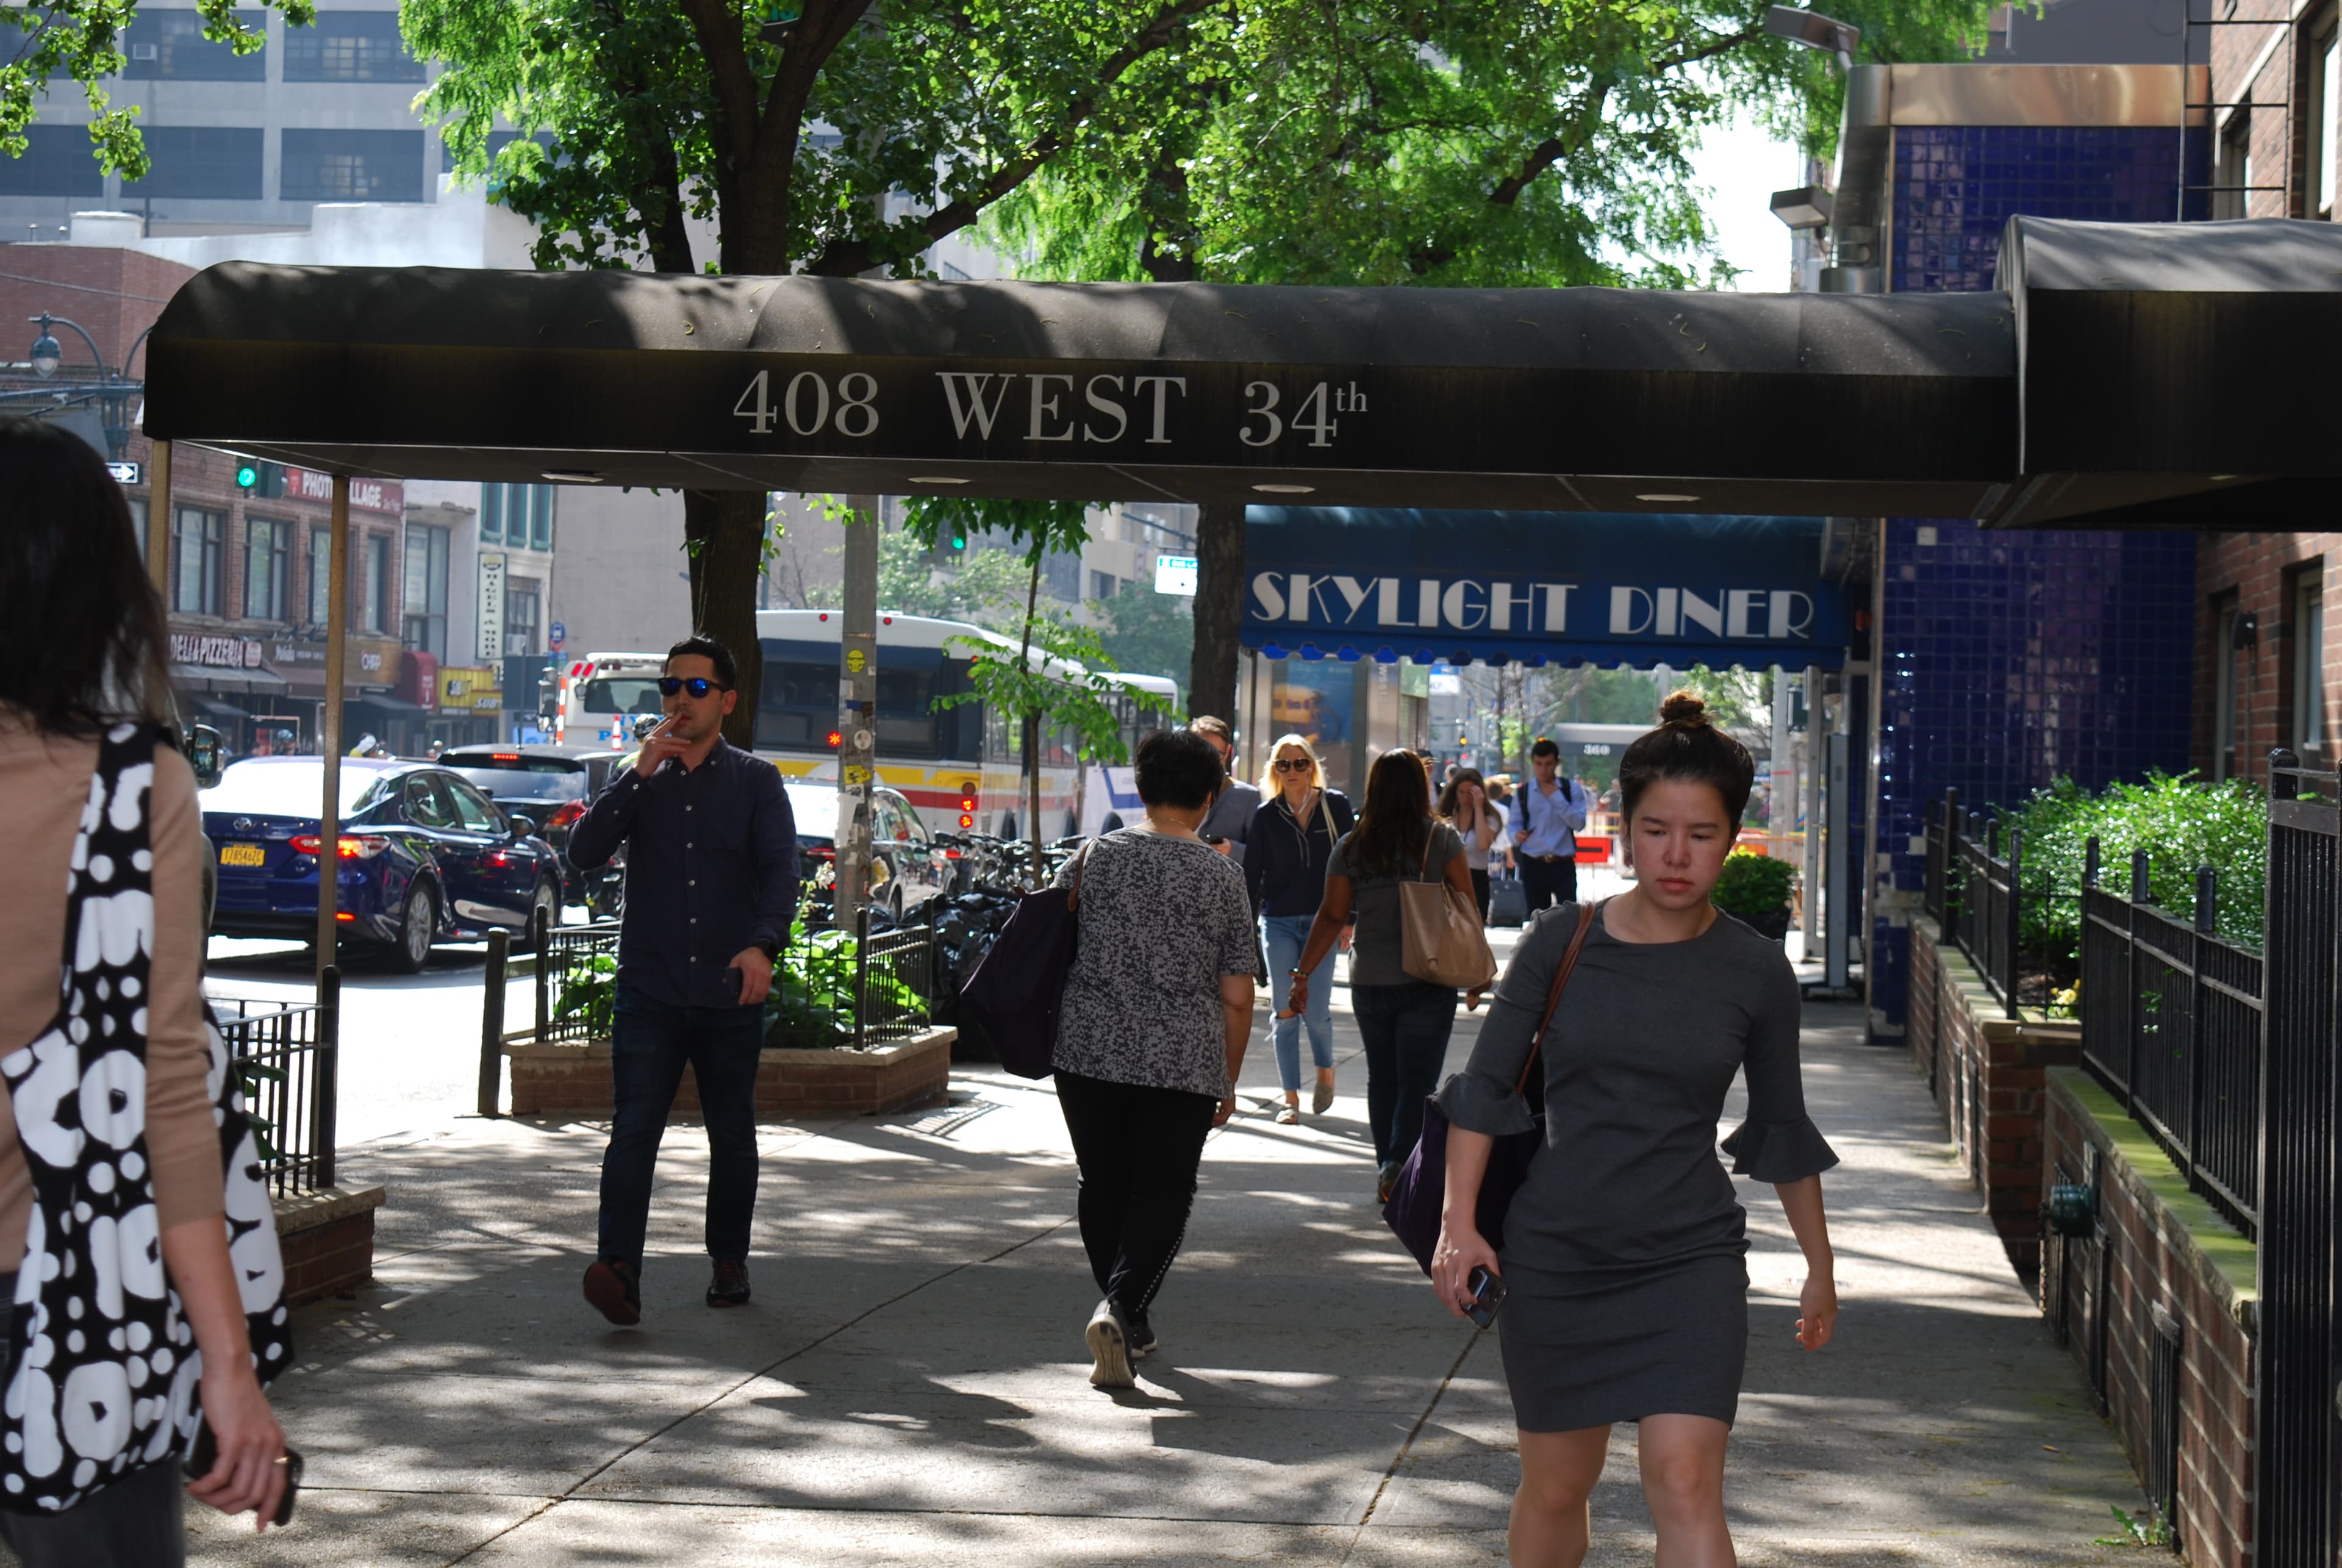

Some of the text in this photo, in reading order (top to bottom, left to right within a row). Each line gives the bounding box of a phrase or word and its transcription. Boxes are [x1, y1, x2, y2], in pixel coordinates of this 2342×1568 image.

[734, 370, 1368, 446] 408 WEST 34th
[1252, 571, 1813, 638] SKYLIGHT DINER
